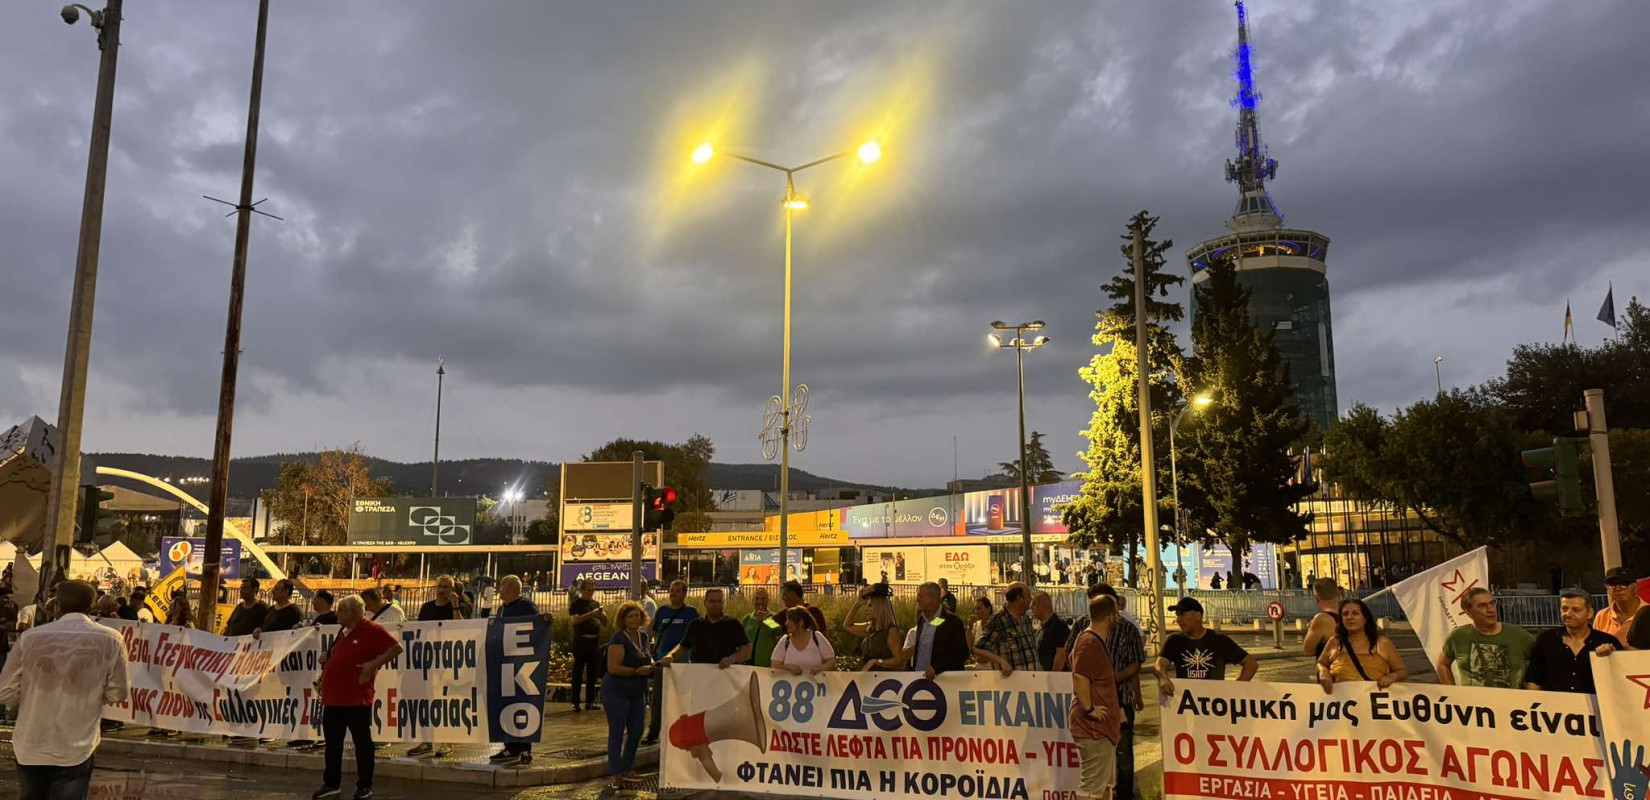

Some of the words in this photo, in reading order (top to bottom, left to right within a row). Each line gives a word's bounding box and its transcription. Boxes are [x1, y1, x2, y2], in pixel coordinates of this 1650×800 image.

[688, 534, 706, 542] Hertz
[945, 552, 969, 561] ΕΔΩ
[576, 572, 629, 580] AEGEAN
[153, 632, 240, 682] Στεγαστική
[281, 650, 303, 672] και
[306, 650, 317, 671] οι
[402, 629, 476, 681] Τάρταρα
[130, 687, 158, 720] μας
[156, 681, 195, 719] πίσω
[195, 701, 213, 726] τις
[213, 686, 299, 734] Συλλογικές
[387, 686, 478, 738] Εργασίας!
[1177, 689, 1297, 725] Ατομική
[1308, 699, 1359, 728] μας
[1370, 692, 1496, 729] Ευθύνη
[1509, 702, 1601, 738] είναι
[769, 729, 822, 756] ΔΩΣΤΕ
[826, 734, 887, 760] ΛΕΦΤΑ
[891, 737, 923, 760] ΓΙΑ
[927, 737, 1019, 765] ΠΡΟΝΟΙΑ
[1173, 732, 1196, 765] Ο
[1206, 734, 1428, 775] ΣΥΛΛΟΓΙΚΟΣ
[1440, 745, 1605, 798] ΑΓΩΝΑΣ
[737, 761, 823, 788] ΦΤΑΝΕΙ
[830, 769, 872, 791] ΠΙΑ
[879, 771, 896, 793] Η
[904, 769, 1029, 800] ΚΟΡΟΪΔΙΑ
[1199, 777, 1271, 798] ΕΡΓΑΣΙΑ
[1291, 783, 1349, 800] ΥΓΕΙΑ
